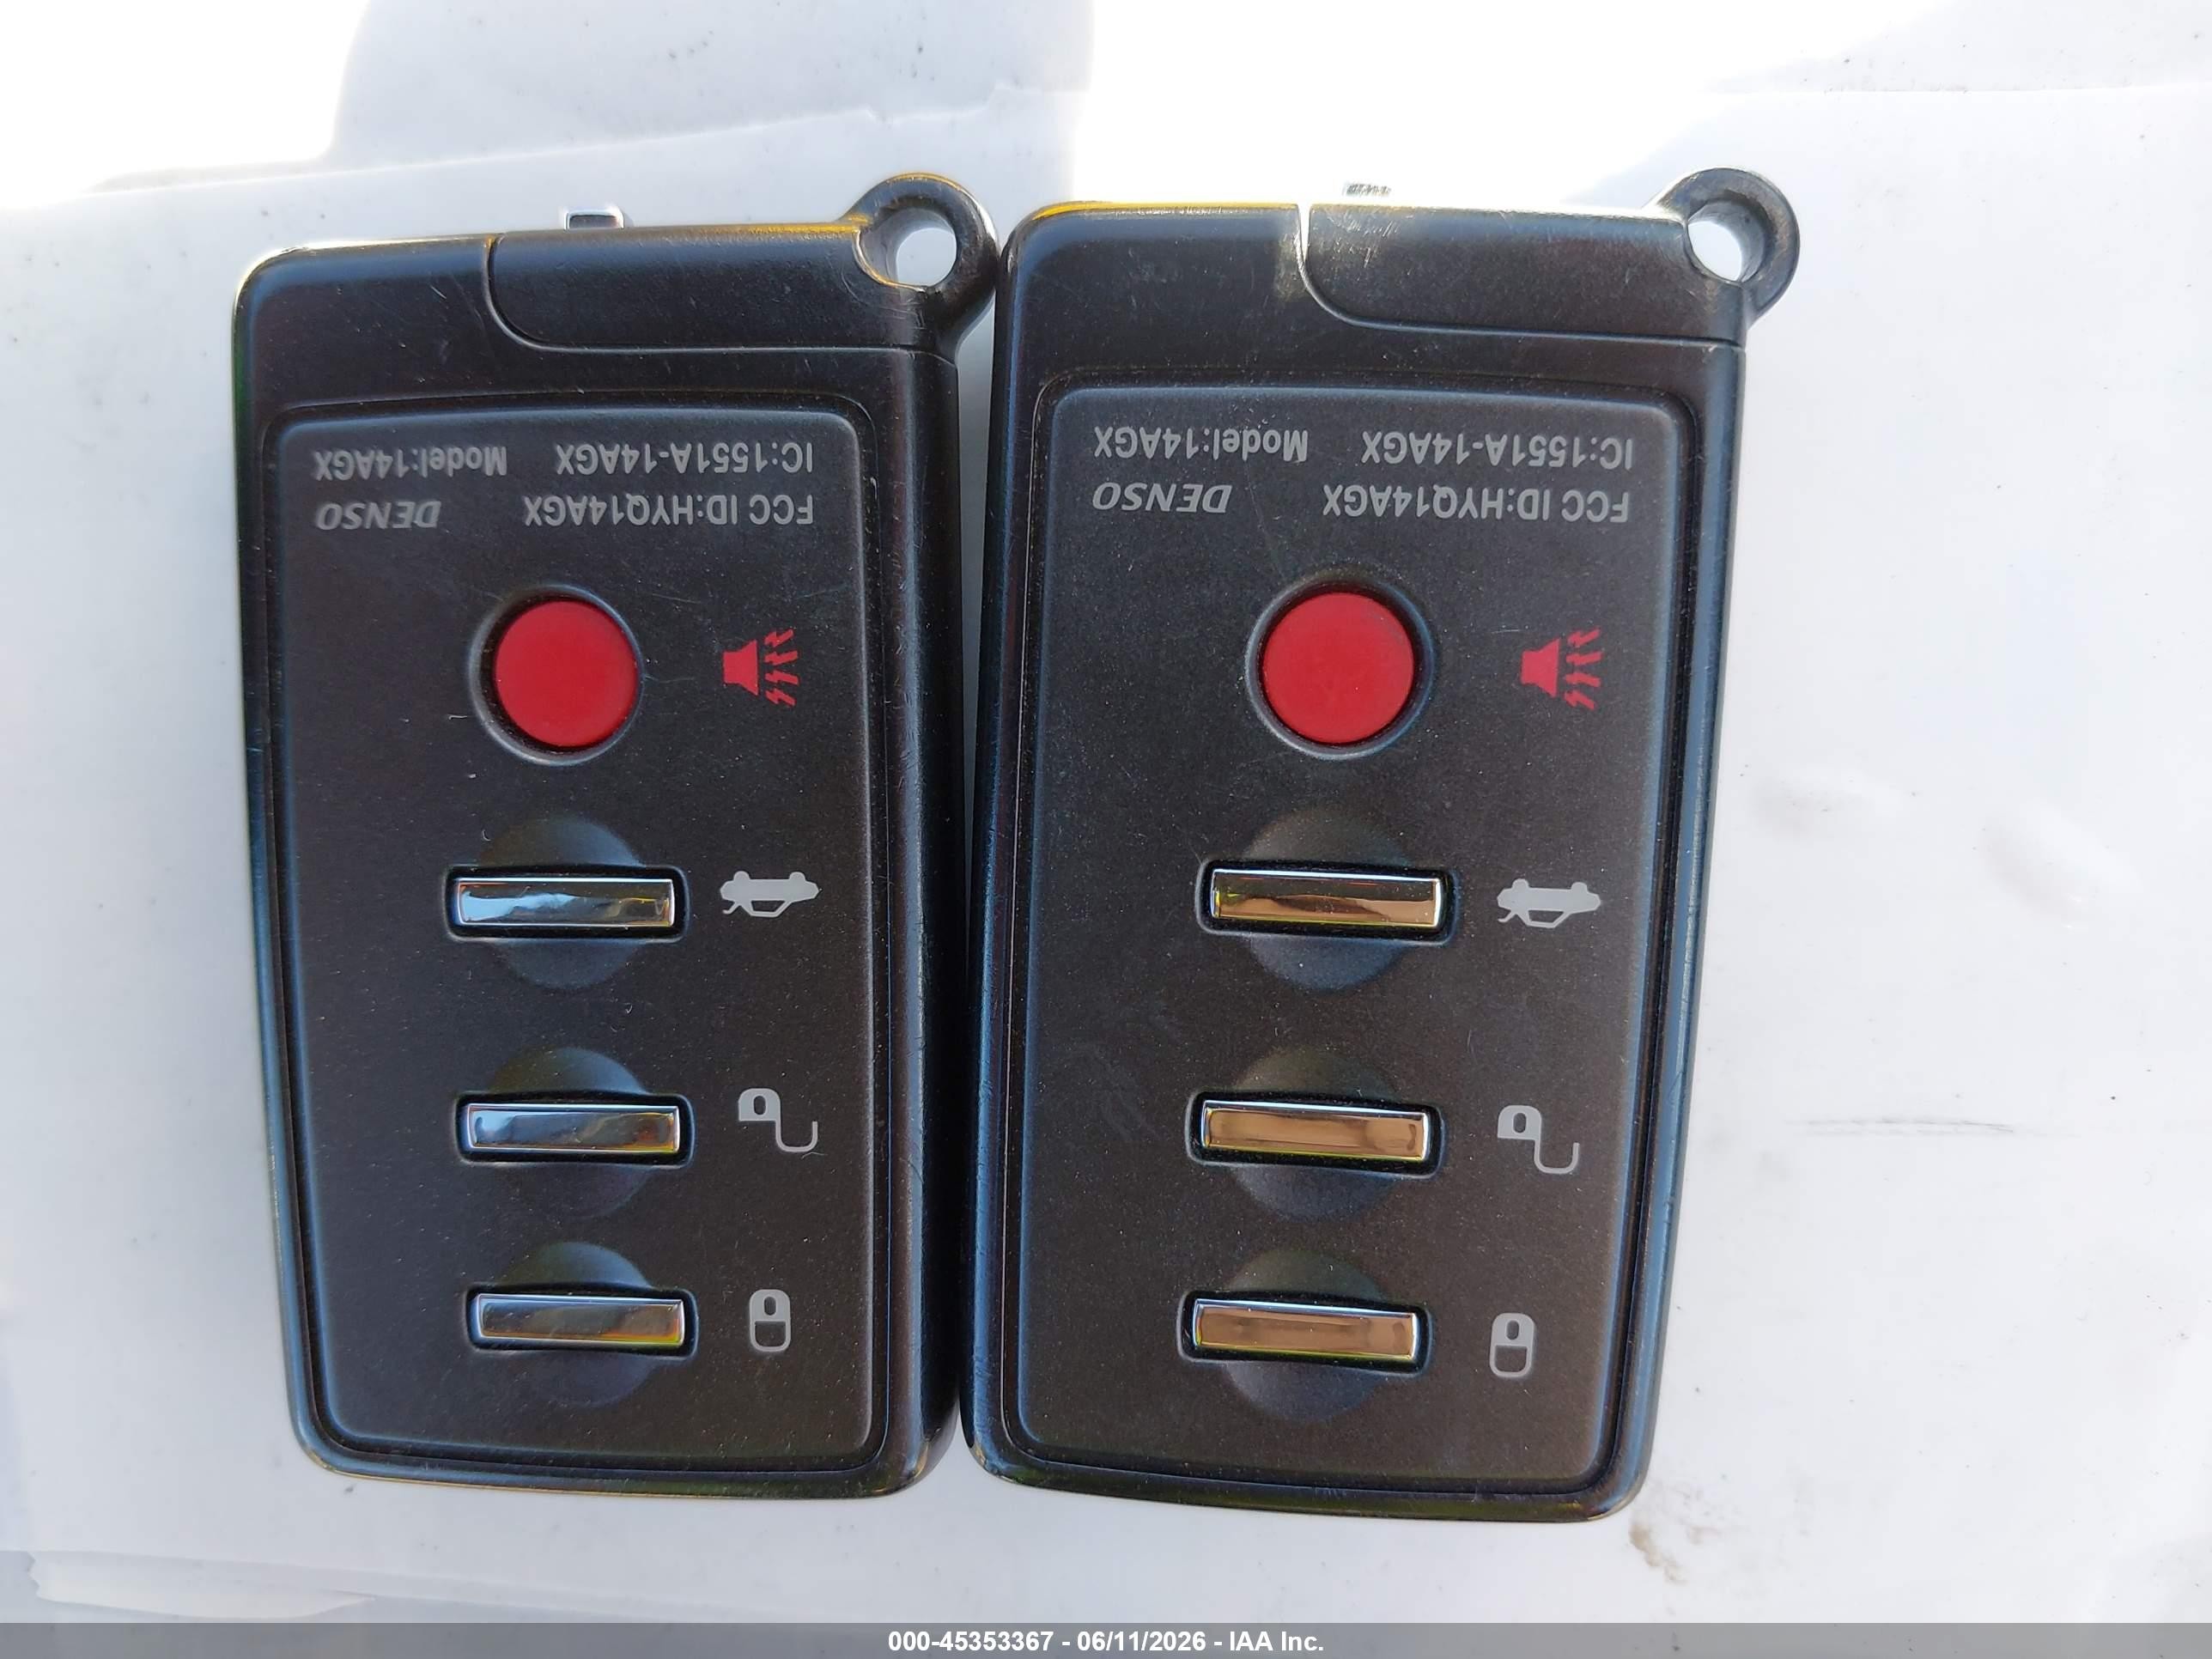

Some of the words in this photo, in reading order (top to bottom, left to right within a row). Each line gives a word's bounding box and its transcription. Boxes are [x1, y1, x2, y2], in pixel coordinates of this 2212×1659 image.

[555, 442, 813, 474] IC:1551A-14AGX
[1093, 427, 1309, 462] Model:14AGX
[1361, 431, 1633, 470] IC:1551A-14AGX
[313, 444, 507, 480] Model:14AGX
[523, 493, 738, 526] ID:HYQ14AGX
[750, 494, 814, 525] FCC
[1092, 482, 1233, 514] DENSO
[1322, 484, 1551, 521] ID:HYQ14AGX
[1561, 489, 1630, 523] FCC
[315, 501, 442, 531] DENSO
